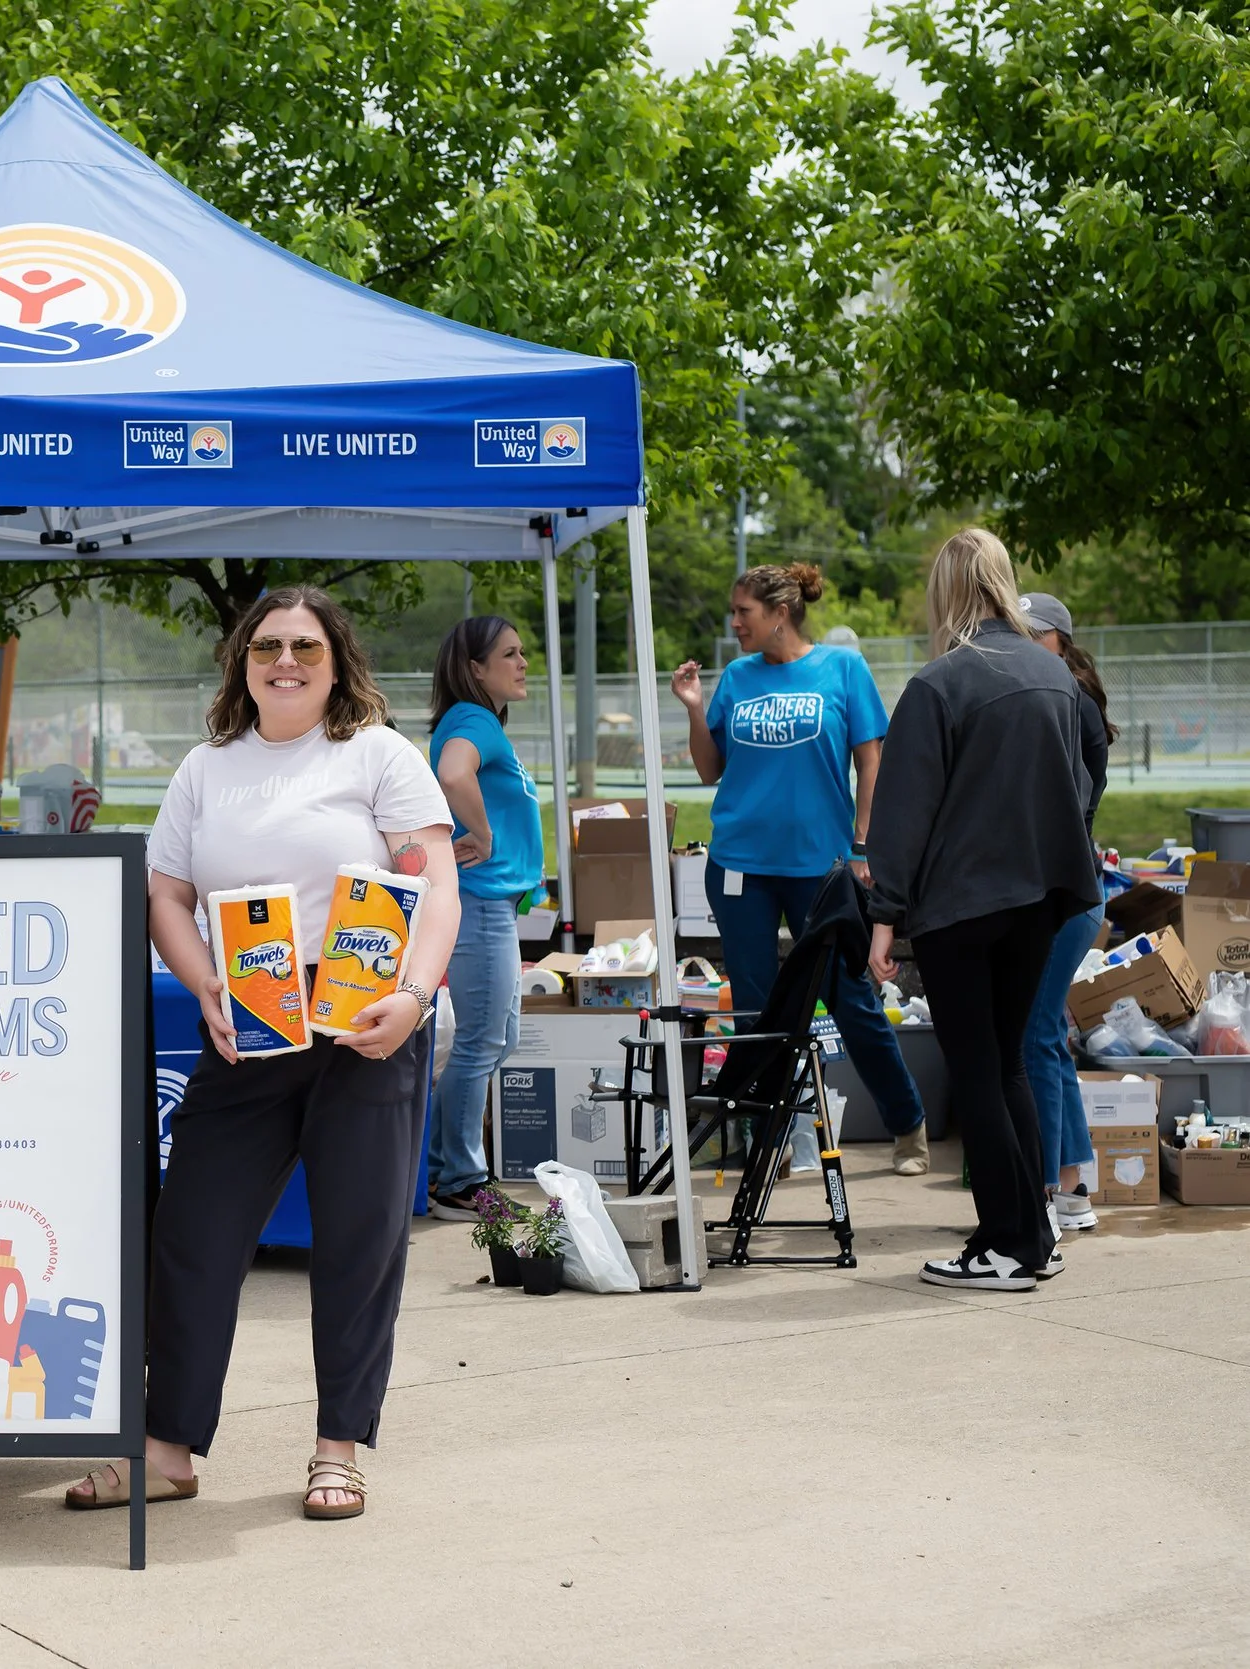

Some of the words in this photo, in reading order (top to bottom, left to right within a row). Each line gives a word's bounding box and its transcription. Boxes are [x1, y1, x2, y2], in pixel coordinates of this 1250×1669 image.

[129, 426, 184, 443] United
[480, 425, 536, 442] United
[150, 443, 184, 463] Way
[283, 434, 330, 456] LIVE
[336, 433, 417, 456] UNITED
[502, 441, 536, 462] Way
[736, 697, 816, 720] MEMBERS
[752, 719, 796, 742] FIRST
[331, 932, 391, 953] Towels
[1224, 943, 1249, 954] Total
[237, 946, 285, 971] Towels
[327, 978, 344, 987] Strong
[349, 983, 377, 993] Absorbent
[505, 1077, 532, 1086] TORK
[830, 1175, 842, 1216] ROCKER
